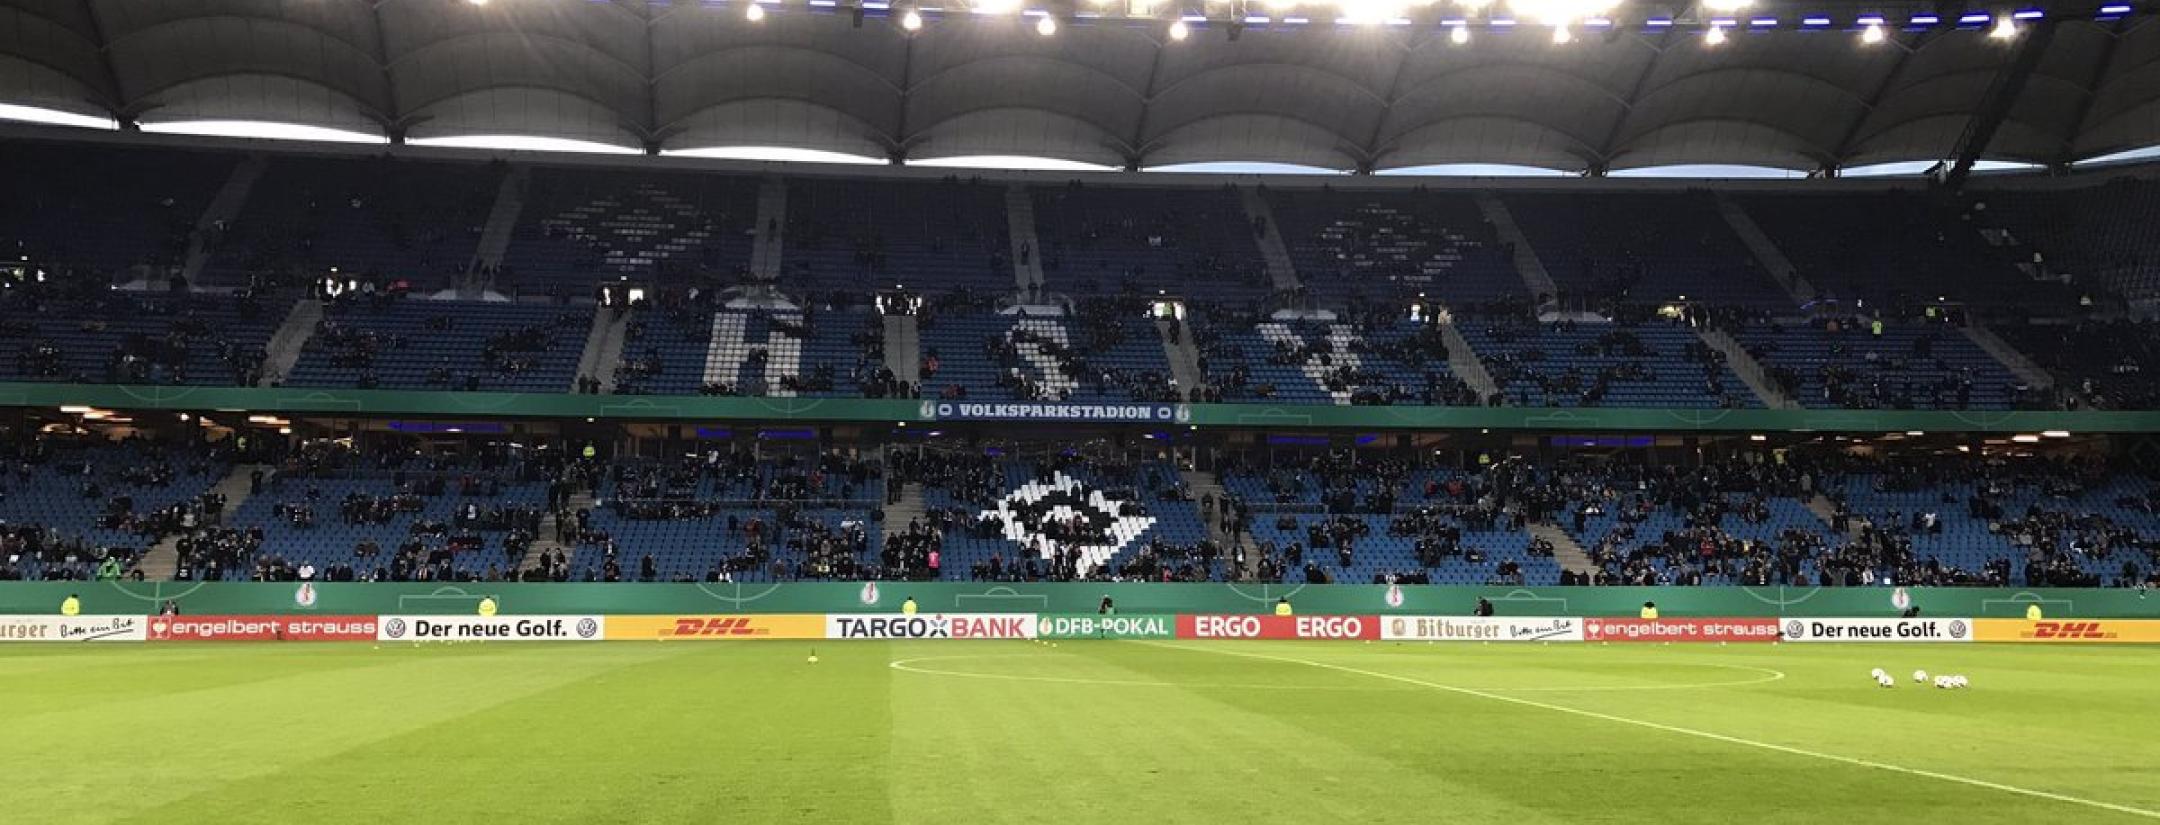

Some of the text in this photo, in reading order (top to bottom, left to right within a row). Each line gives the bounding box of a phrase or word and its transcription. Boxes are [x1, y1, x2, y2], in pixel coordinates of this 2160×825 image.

[959, 403, 1151, 418] VOLKSPARKSTADION
[172, 619, 376, 639] engelbert strauss
[415, 619, 567, 636] Der neue Golf.
[675, 618, 754, 635] DHL
[1056, 617, 1168, 635] DFB-POKAL
[1195, 616, 1261, 636] ERGO
[1296, 617, 1362, 637] ERGO
[1417, 619, 1500, 638] Bitburger
[1604, 622, 1778, 640] engelbert strauss
[1812, 622, 1941, 638] Der neue Golf.
[2034, 623, 2104, 638] DHL
